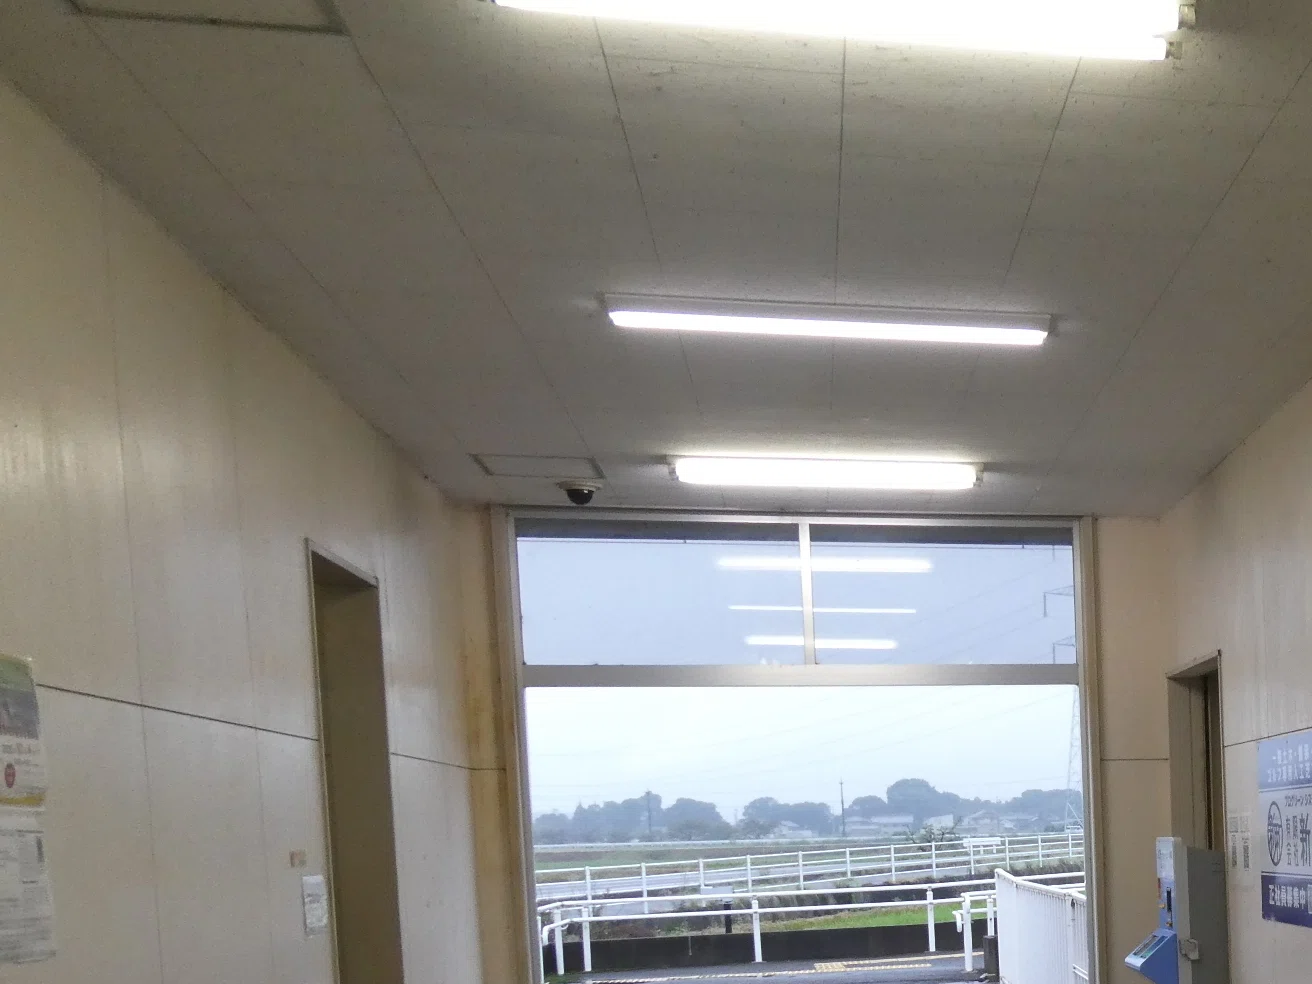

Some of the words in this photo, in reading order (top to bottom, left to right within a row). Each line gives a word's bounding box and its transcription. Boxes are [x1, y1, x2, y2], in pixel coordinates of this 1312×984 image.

[1268, 884, 1306, 909] 正社員募集中
